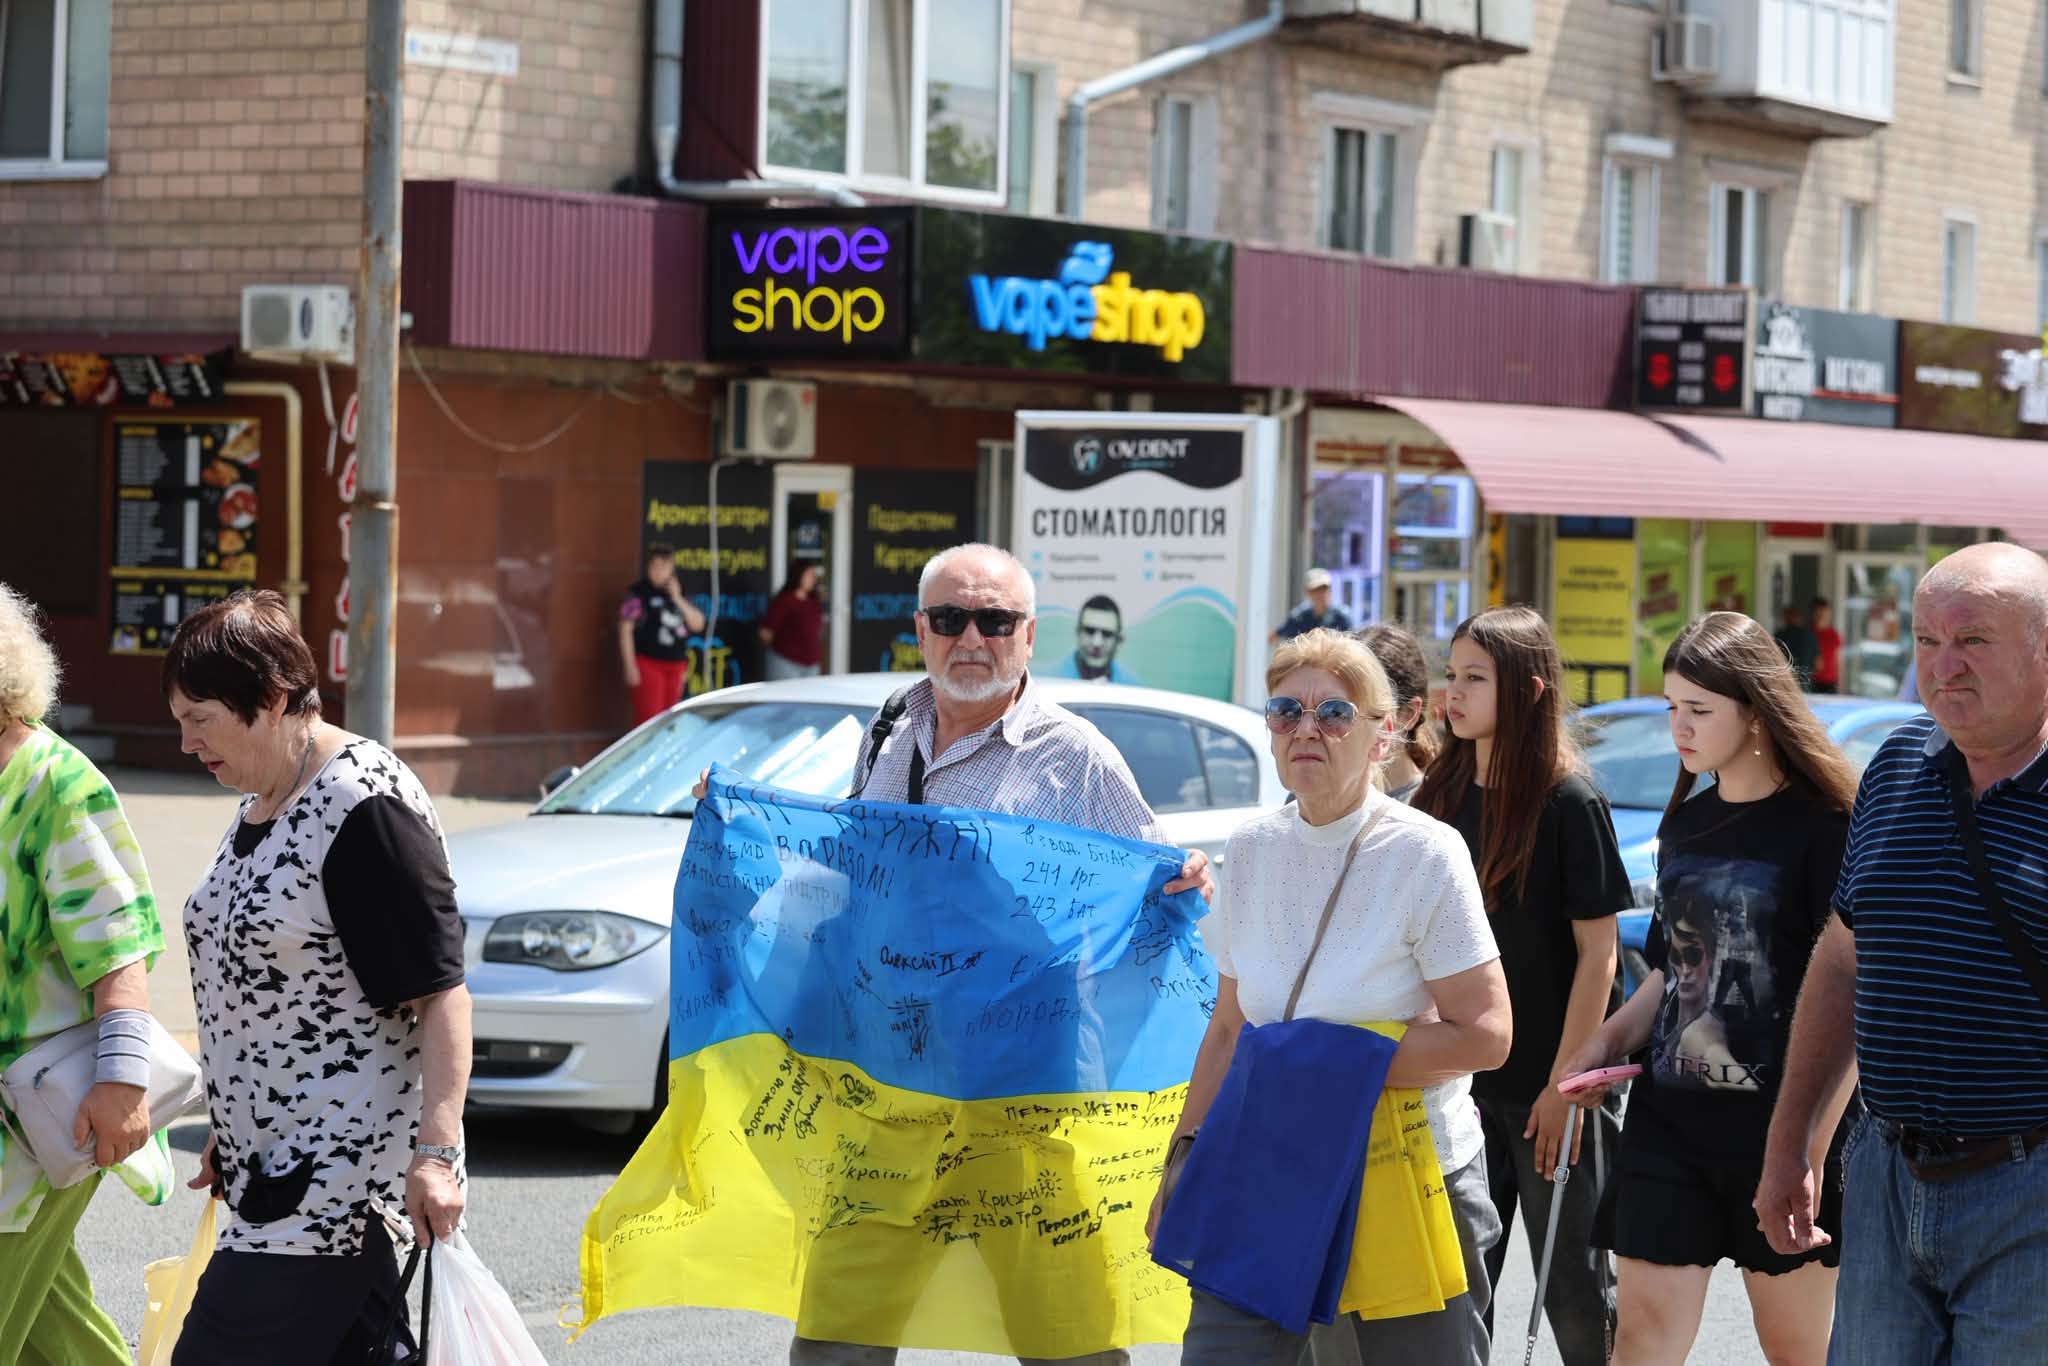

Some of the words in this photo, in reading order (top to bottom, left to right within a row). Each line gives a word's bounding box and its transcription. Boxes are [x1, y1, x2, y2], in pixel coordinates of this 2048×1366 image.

[732, 227, 889, 285] vape
[732, 277, 885, 344] shop
[1032, 507, 1227, 539] СТОМАТОЛОГІЯ
